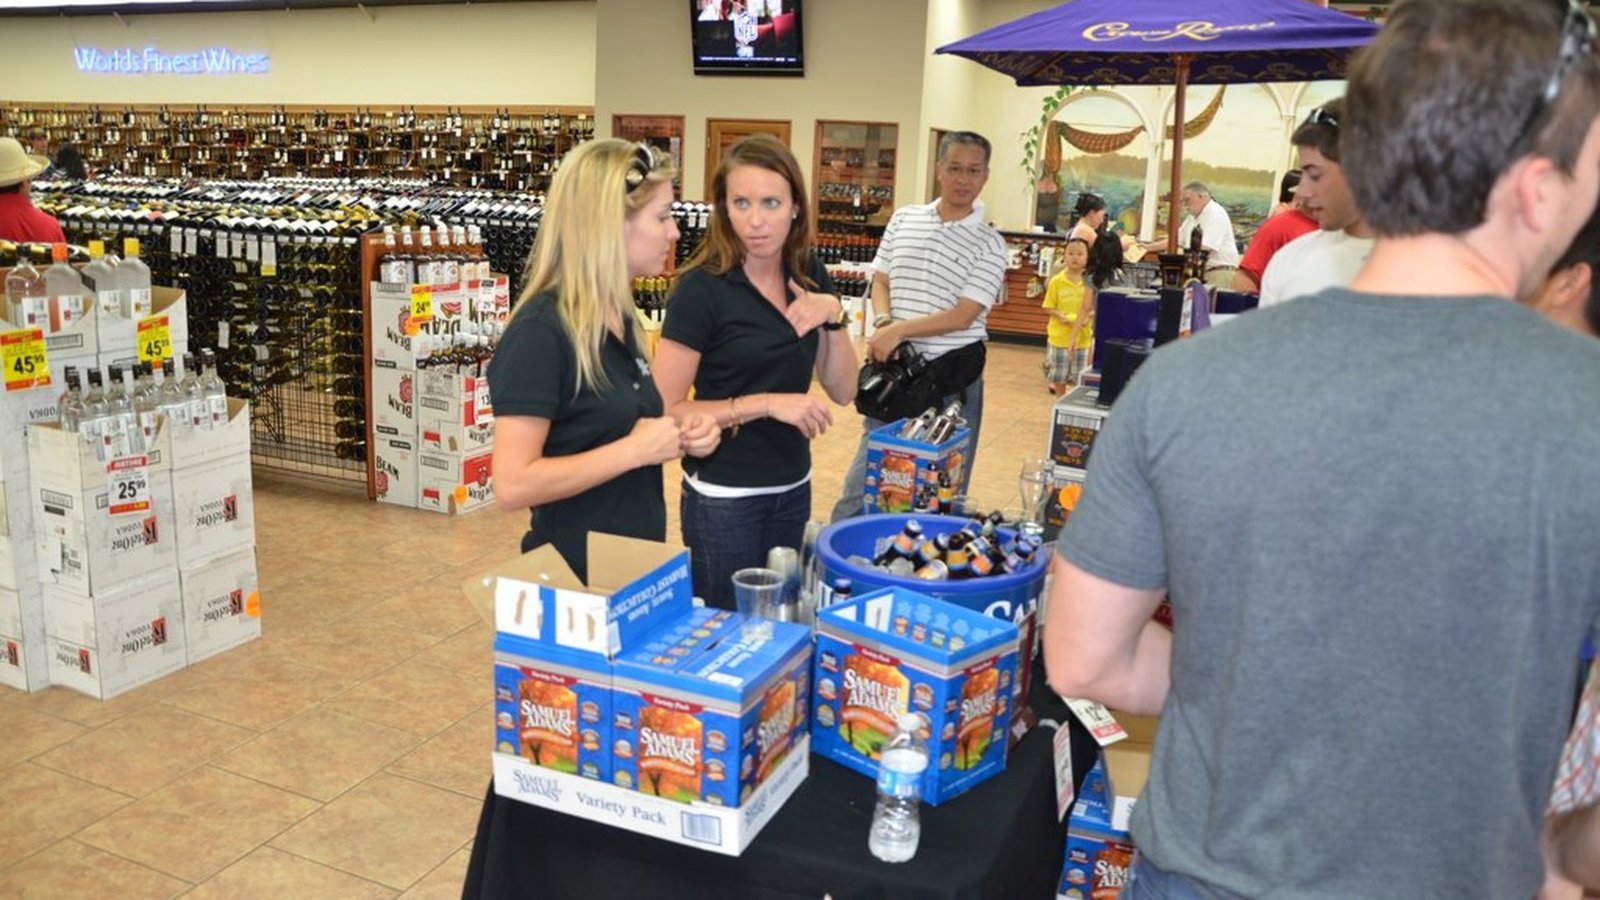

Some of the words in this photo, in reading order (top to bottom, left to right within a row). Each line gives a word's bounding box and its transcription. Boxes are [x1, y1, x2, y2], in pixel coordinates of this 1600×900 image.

[74, 47, 140, 72] Worlds
[142, 47, 200, 72] Finest
[203, 47, 270, 73] Wines
[843, 667, 901, 701] SAMUEL
[520, 698, 571, 720] SAMUEL
[846, 688, 900, 723] ADAMS
[525, 713, 576, 737] ADAMS
[640, 726, 697, 750] SAMUEL
[644, 742, 700, 767] ADAMS
[513, 768, 559, 790] SAMUEL
[518, 779, 563, 802] ADAMS
[576, 791, 628, 817] Variety
[631, 806, 667, 825] Pack
[1093, 859, 1127, 882] SAM
